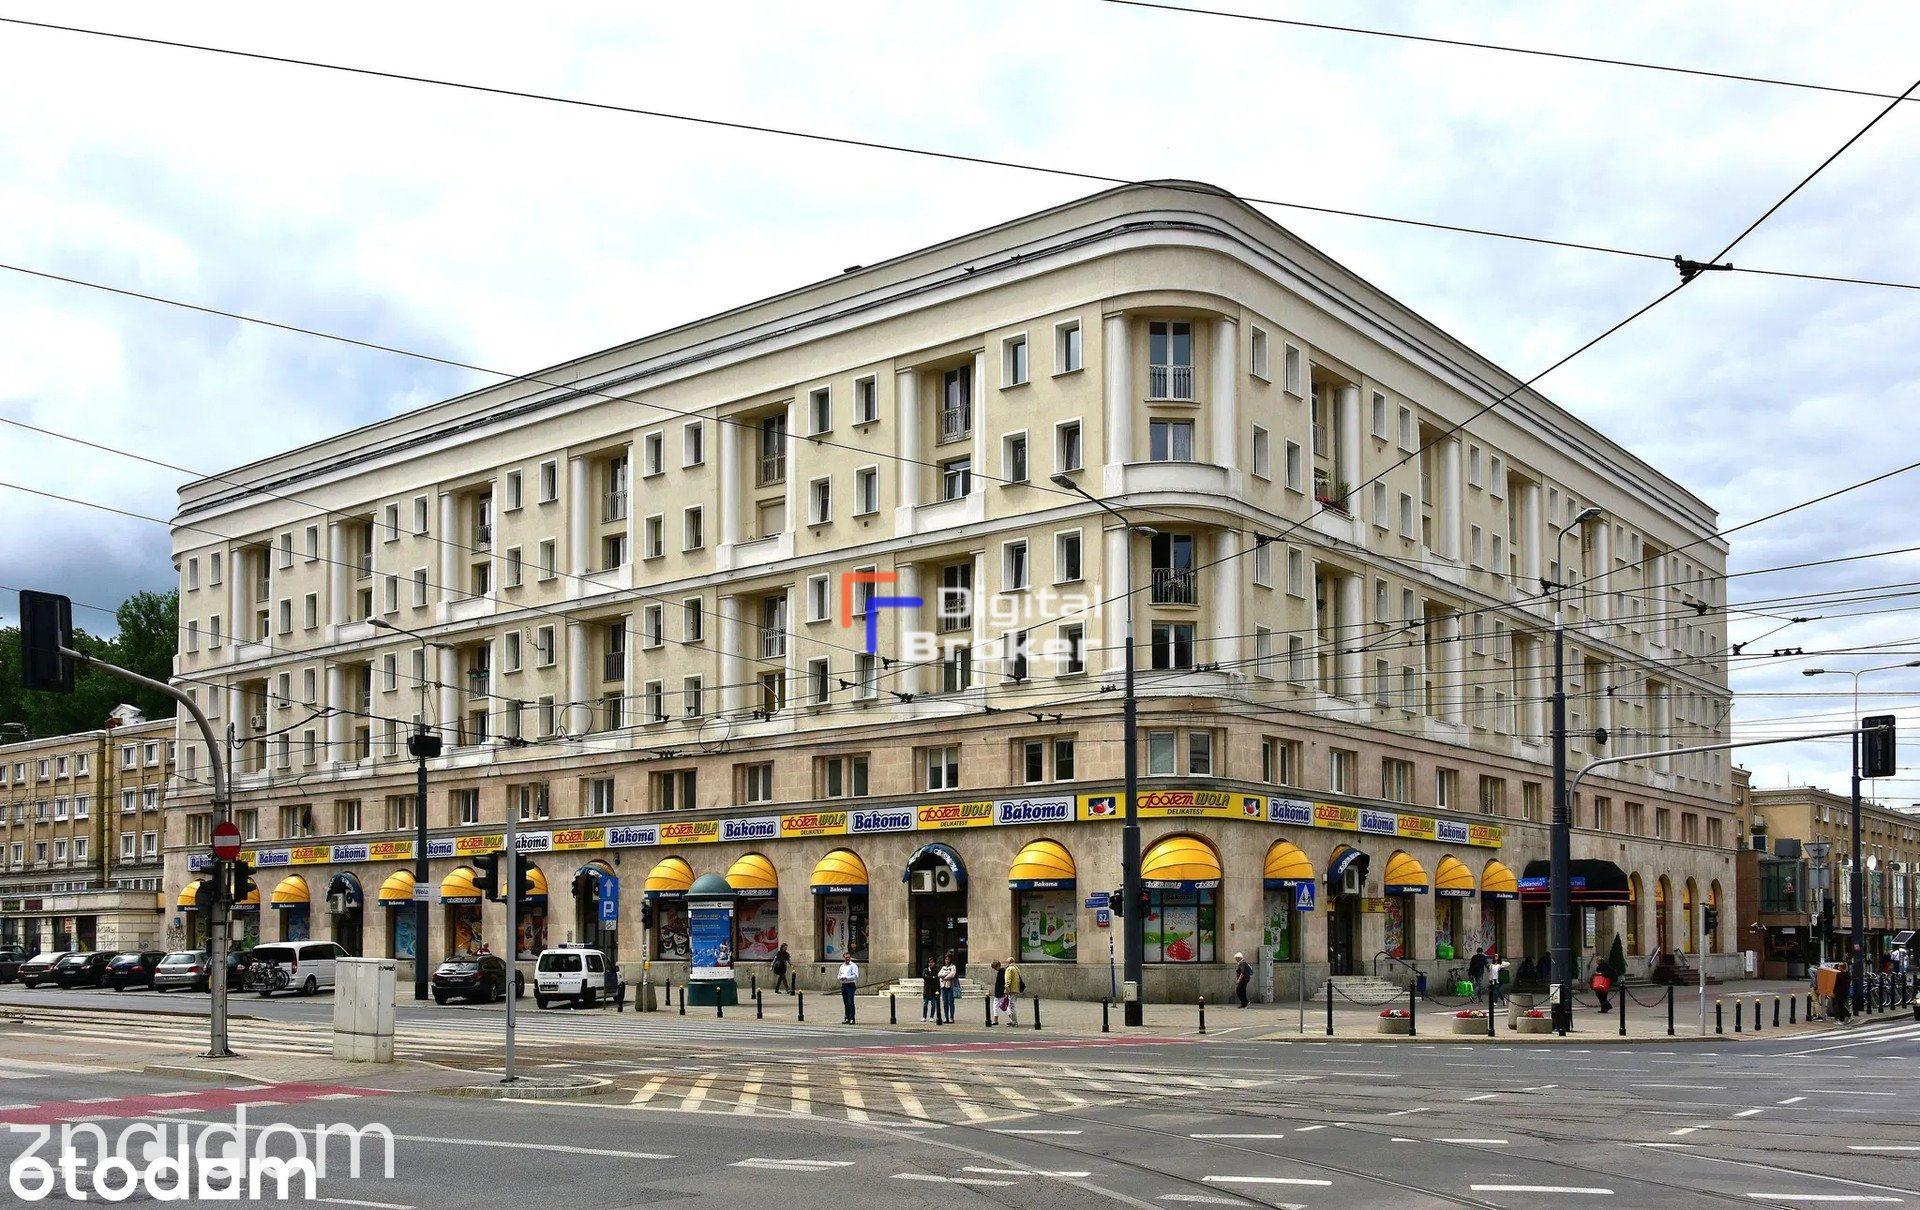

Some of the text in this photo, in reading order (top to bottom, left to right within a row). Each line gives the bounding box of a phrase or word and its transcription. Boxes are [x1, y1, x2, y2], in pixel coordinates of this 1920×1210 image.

[1194, 792, 1231, 807] WOLA
[960, 803, 992, 817] WOLA
[1002, 801, 1066, 821] Bakoma
[1272, 799, 1310, 822] Bakoma
[818, 813, 846, 826] WOLA
[854, 811, 910, 829] Bakoma
[1361, 811, 1395, 832] Bakoma
[693, 822, 717, 834] WOLA
[725, 820, 774, 838] Bakoma
[1438, 821, 1467, 841] Bakoma
[515, 834, 548, 849] akoma
[610, 828, 654, 845] Bakoma
[334, 845, 366, 860] Bakoma
[427, 841, 452, 854] koma
[258, 850, 288, 864] Bakoma
[603, 901, 614, 918] P
